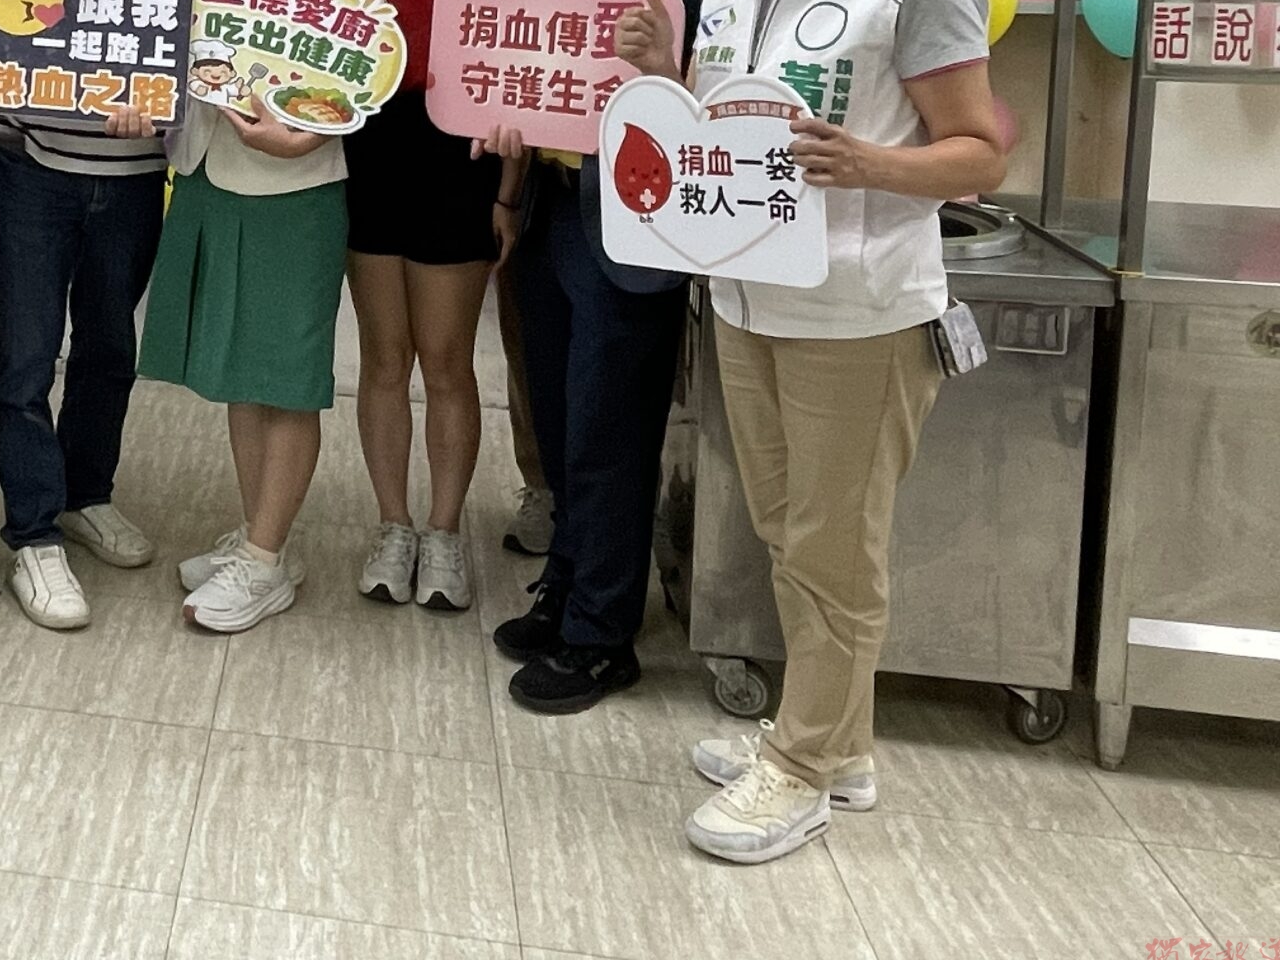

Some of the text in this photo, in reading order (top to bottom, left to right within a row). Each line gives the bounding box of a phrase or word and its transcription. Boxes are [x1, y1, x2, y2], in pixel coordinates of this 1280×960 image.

[32, 29, 177, 68] 一起踏上
[205, 12, 377, 89] 吃出健康
[1154, 6, 1253, 61] 話說
[678, 143, 796, 182] 捐血一袋
[679, 183, 798, 223] 救人一命
